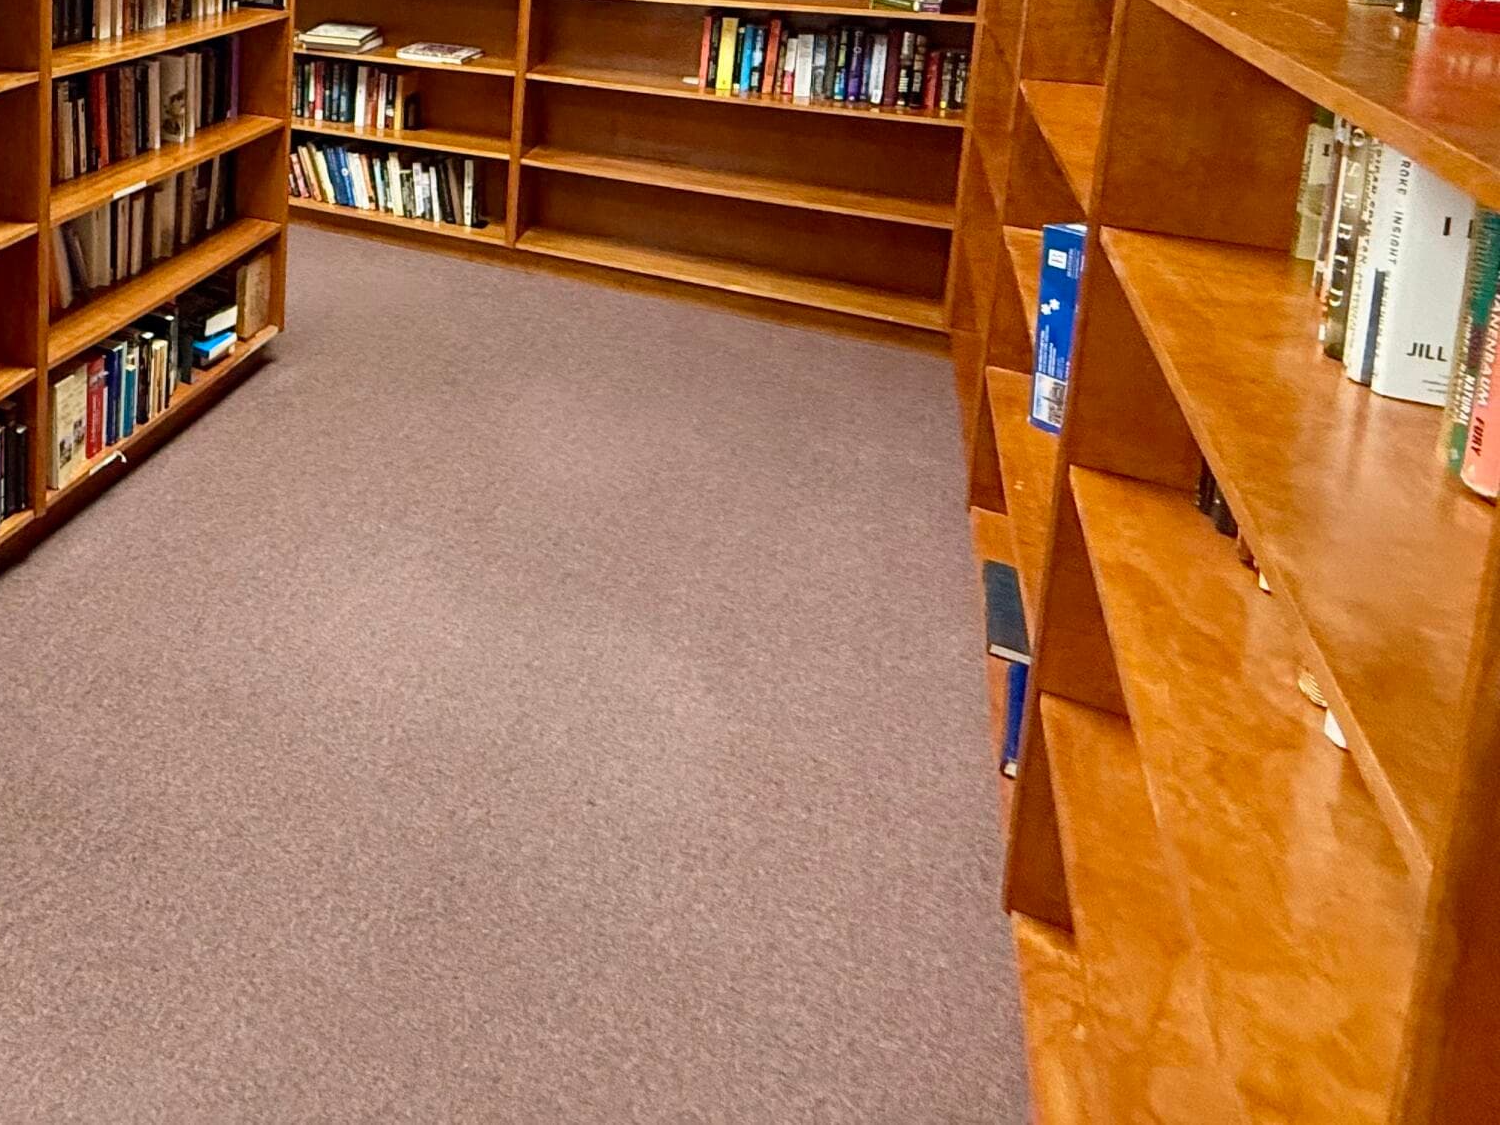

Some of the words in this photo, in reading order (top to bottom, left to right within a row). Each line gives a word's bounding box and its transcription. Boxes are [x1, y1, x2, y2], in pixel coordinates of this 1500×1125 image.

[1398, 158, 1412, 195] ROKE
[1328, 125, 1367, 309] OSEBUD
[1387, 210, 1404, 266] INSIGHT
[1406, 342, 1448, 362] JILL
[1470, 417, 1486, 457] FURY
